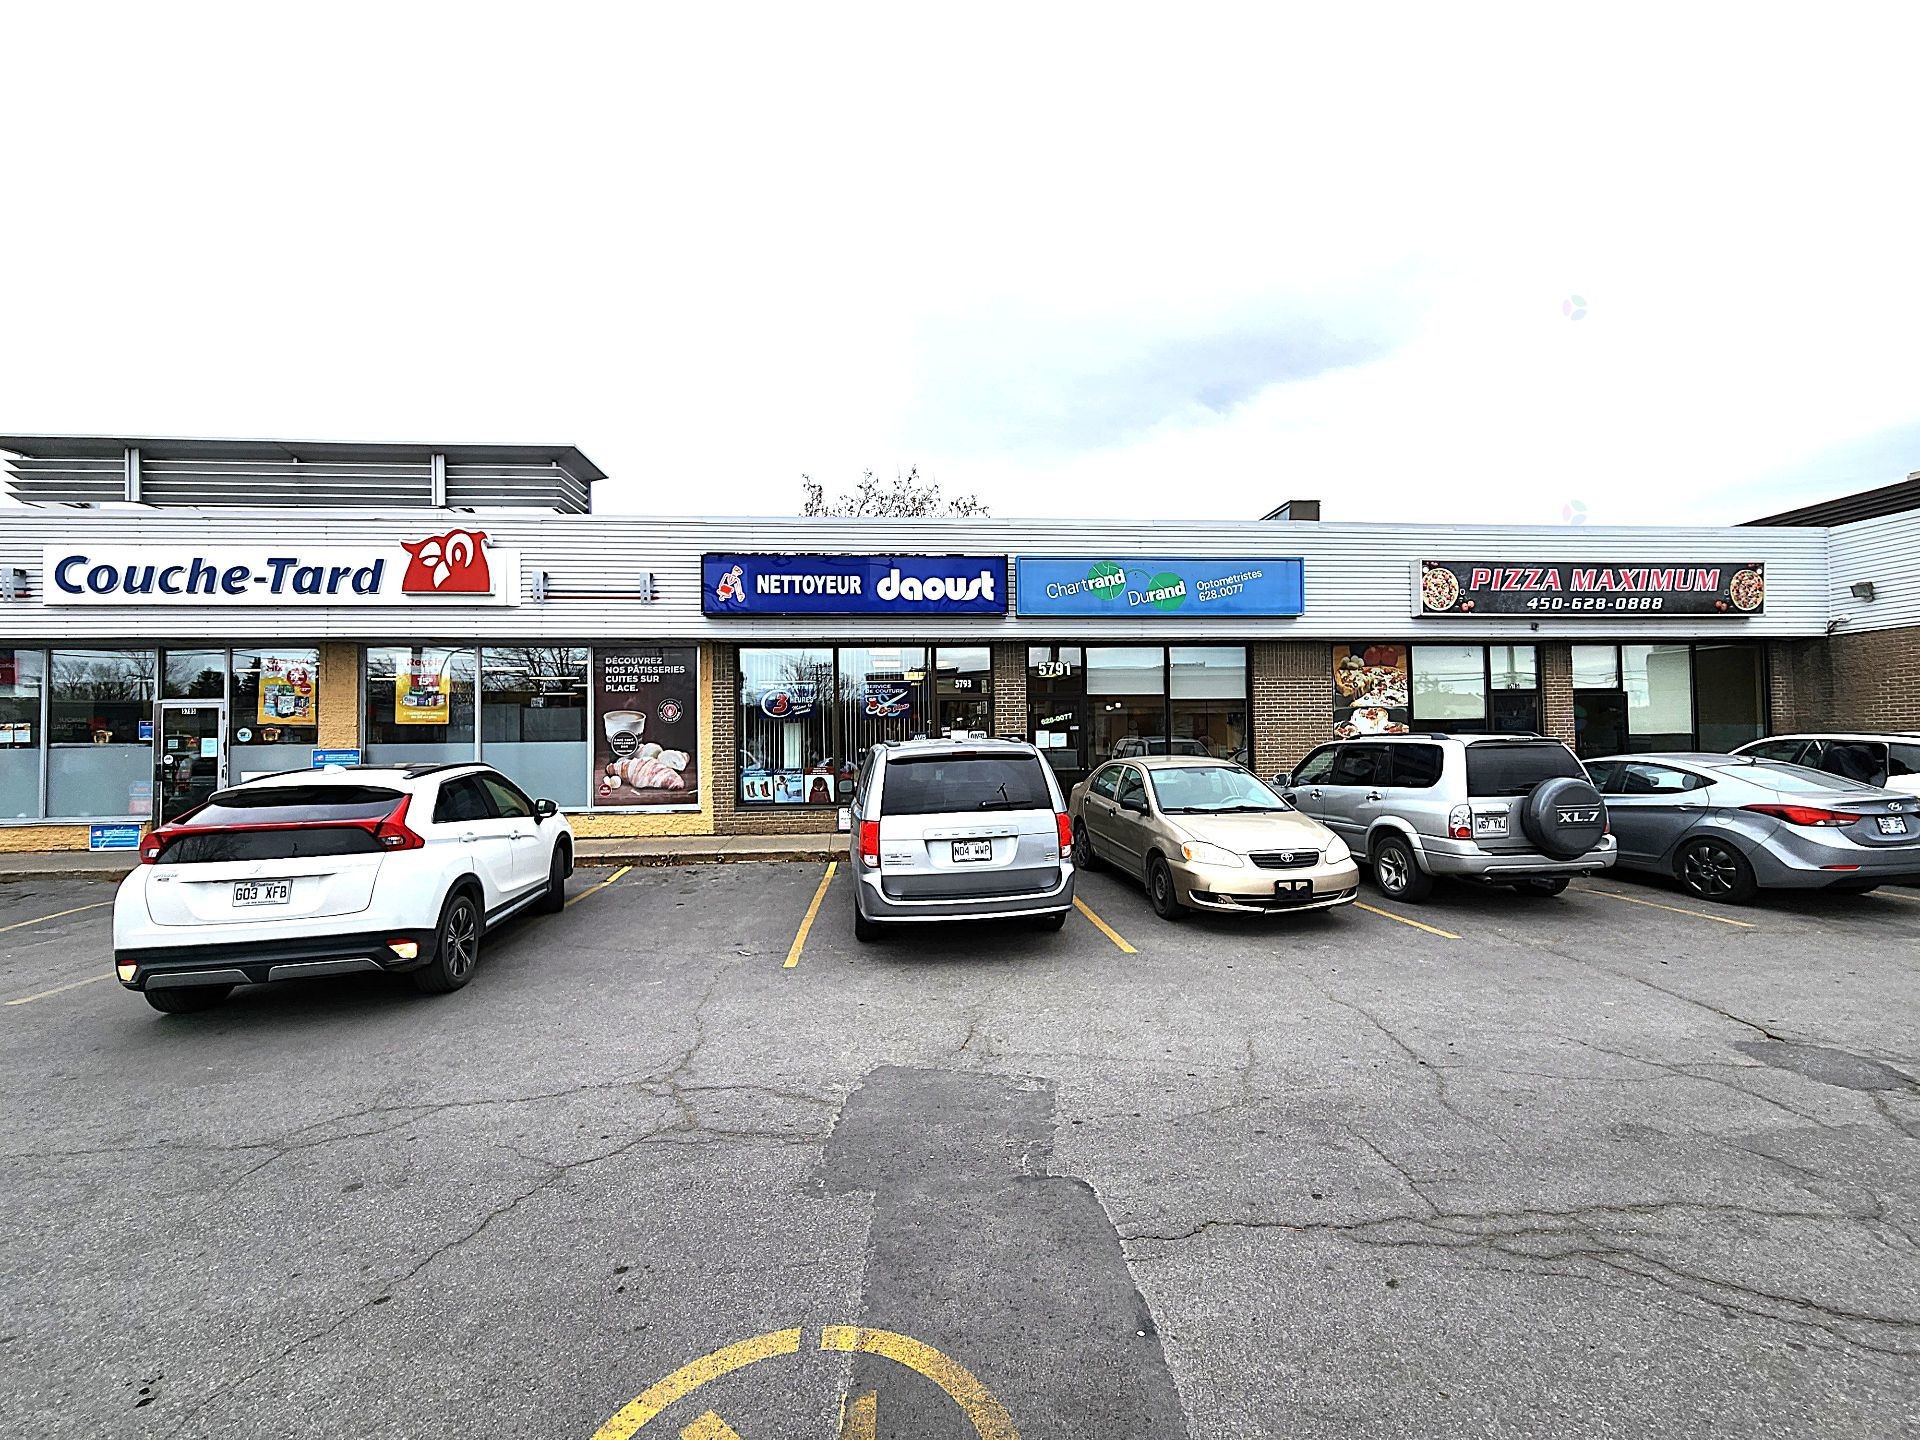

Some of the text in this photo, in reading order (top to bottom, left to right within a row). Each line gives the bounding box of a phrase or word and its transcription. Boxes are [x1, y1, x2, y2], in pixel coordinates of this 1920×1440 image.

[54, 555, 387, 595] Couche-Tard
[1469, 567, 1721, 593] PIZZA MAXIMUM
[756, 568, 995, 601] NETTOYEUR daoust
[1046, 568, 1127, 600] Chartrand
[1127, 580, 1187, 607] Durand
[1198, 583, 1244, 602] 628.0077
[1526, 597, 1663, 610] 450-628-0888
[605, 656, 663, 665] DÉCOUVREZ
[605, 664, 685, 674] NOS PÂTISSERIES
[1038, 661, 1071, 676] 5791
[605, 675, 660, 683] CUITES SUR
[954, 679, 972, 688] 5793
[605, 684, 639, 692] PLACE.
[235, 885, 287, 901] G03 XFB
